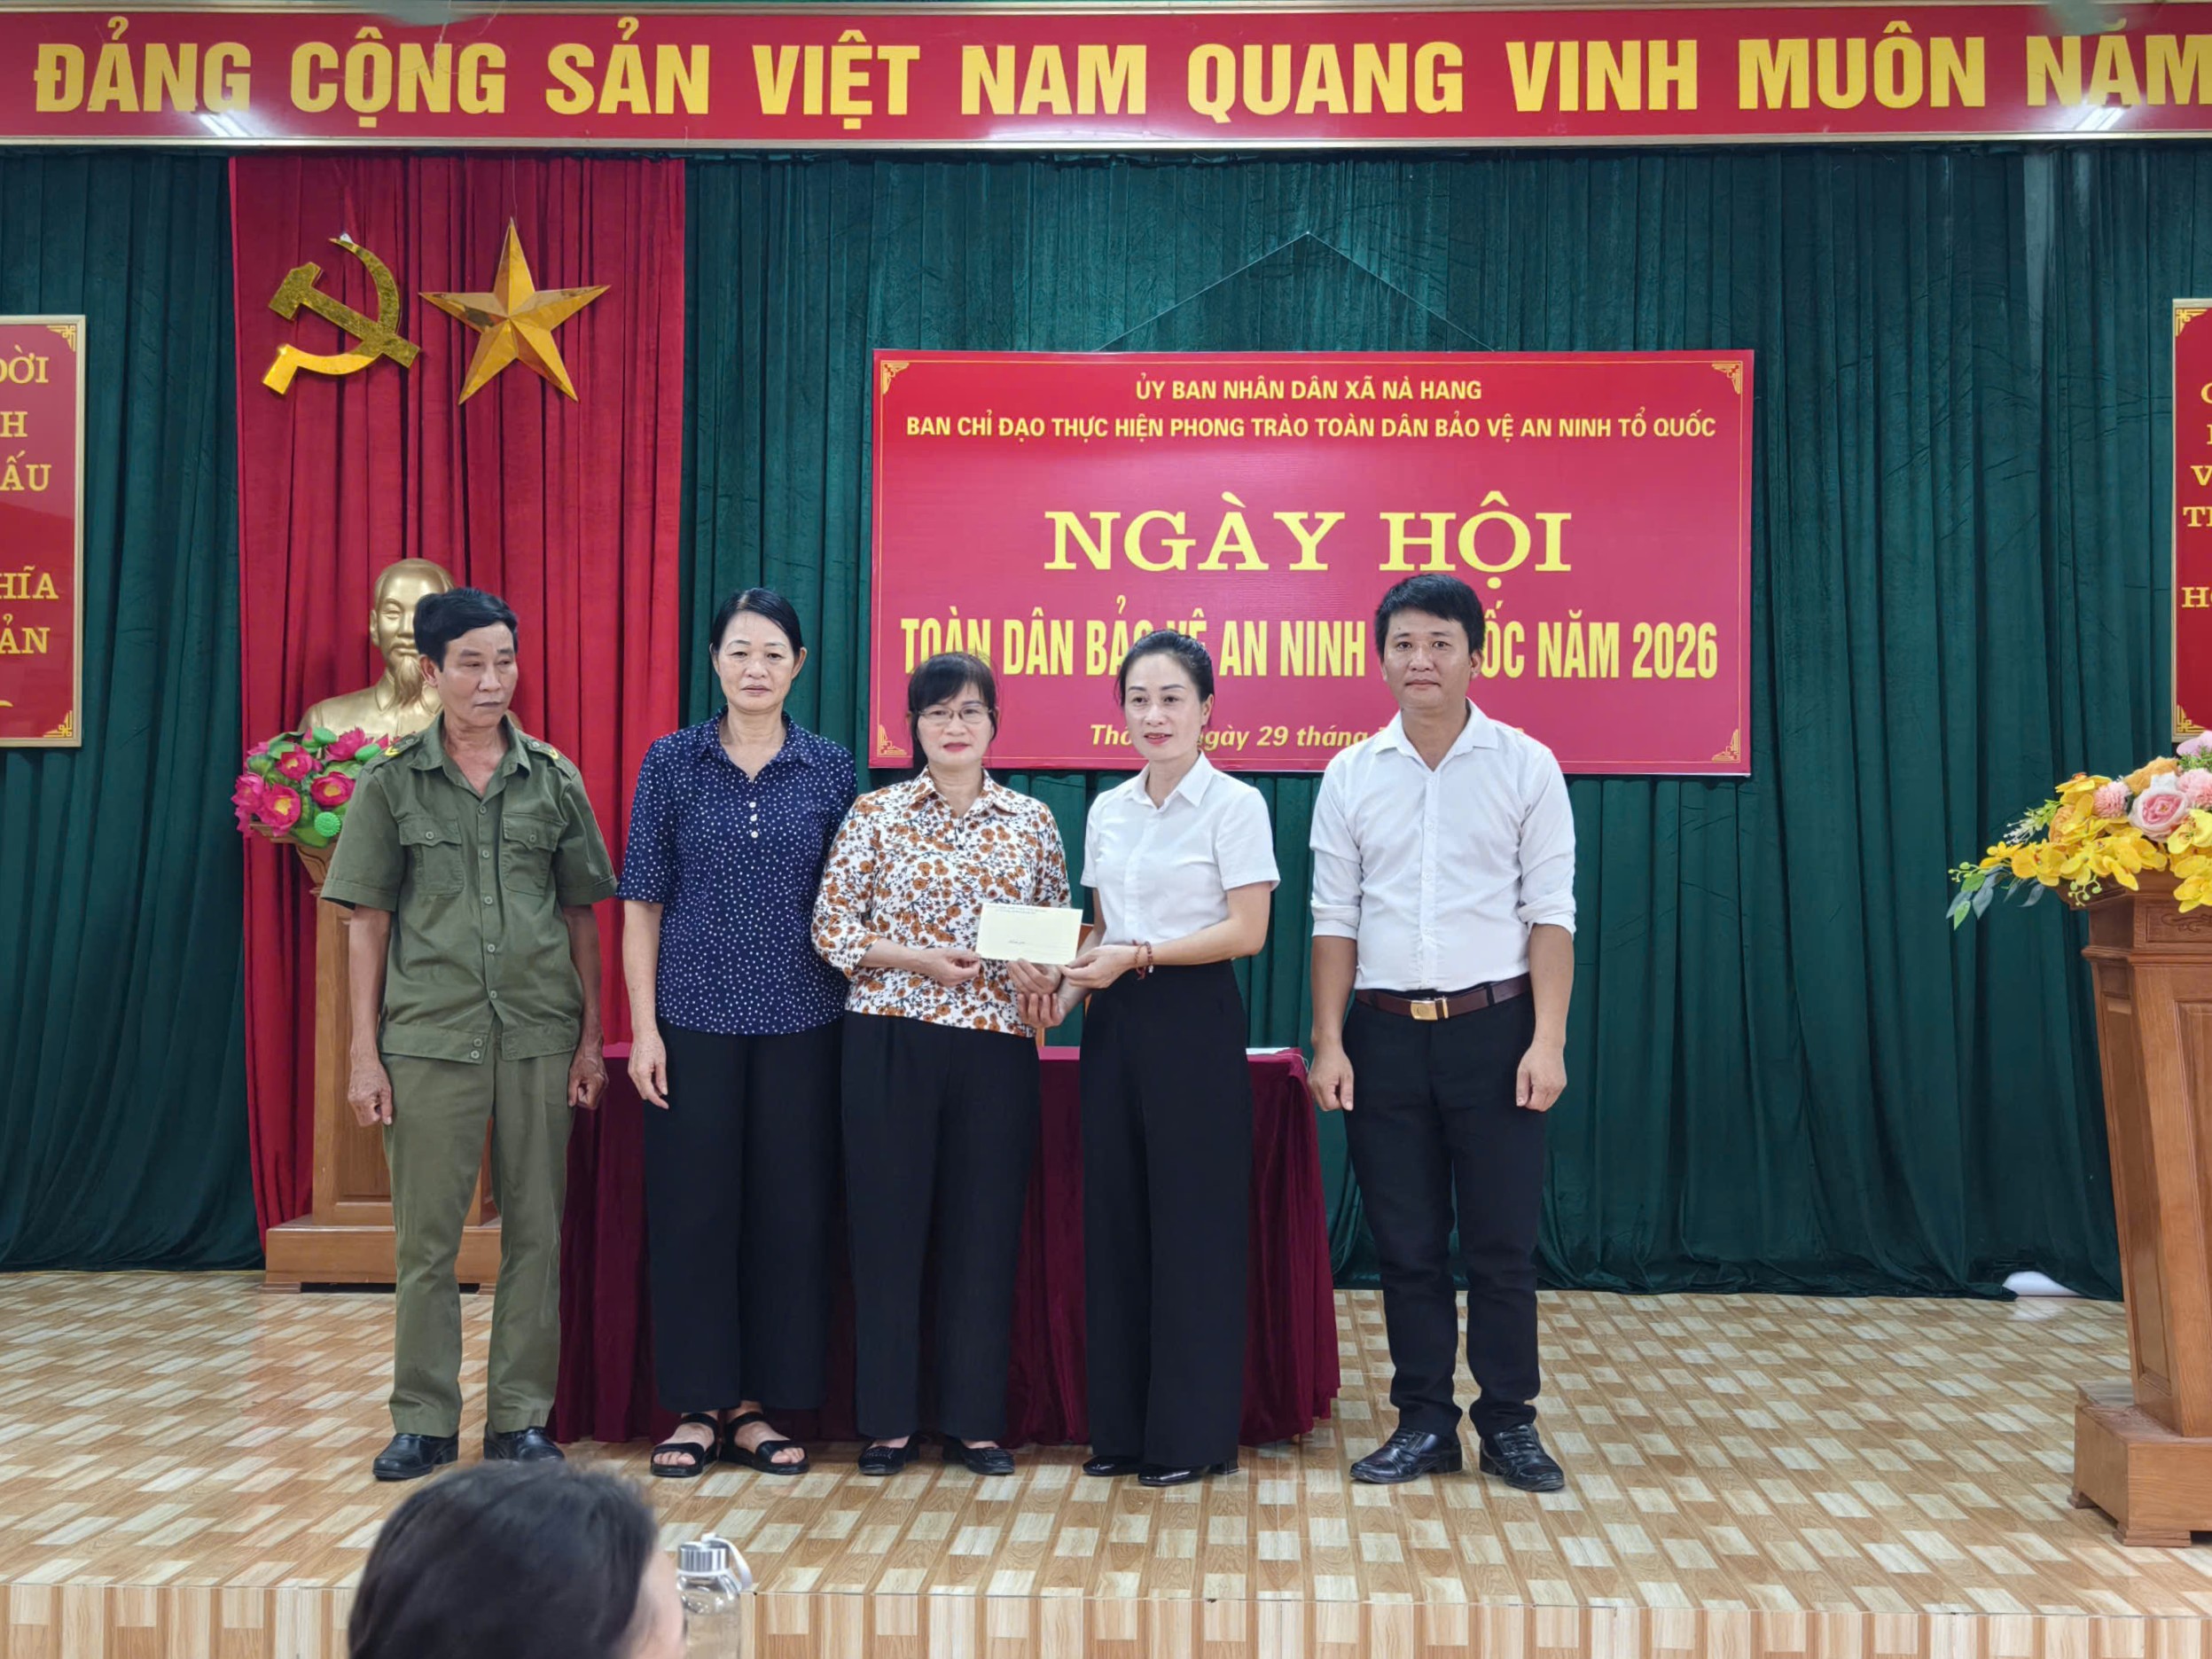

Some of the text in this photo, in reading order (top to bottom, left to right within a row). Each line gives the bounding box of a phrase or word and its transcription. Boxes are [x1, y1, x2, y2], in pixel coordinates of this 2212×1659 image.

[34, 16, 252, 113] ĐẢNG
[290, 27, 506, 129] CỘNG
[545, 16, 710, 115] SẢN
[752, 28, 920, 130] VIỆT
[960, 43, 1147, 115] NAM
[1186, 43, 1464, 124] QUANG
[1505, 39, 1698, 113] VINH
[1739, 20, 1986, 111] MUÔN
[1136, 372, 1482, 401] ỦY BAN NHÂN DÂN XÃ NÀ HANG
[906, 406, 1716, 442] BAN CHỈ ĐẠO THỰC HIỆN PHONG TRÀO TOÀN DÂN BẢO VỆ AN NINH TỔ QUỐC
[1043, 489, 1572, 591] NGÀY HỘI
[901, 606, 991, 674] TOÀN
[1003, 606, 1074, 676] DÂN
[1086, 595, 1153, 677] BẢ
[1219, 620, 1268, 677] AN
[1279, 620, 1366, 677] NINH
[1538, 609, 1620, 678] NĂM
[1632, 622, 1718, 679] 2026
[1200, 724, 1250, 752] gày
[1256, 726, 1289, 747] 29
